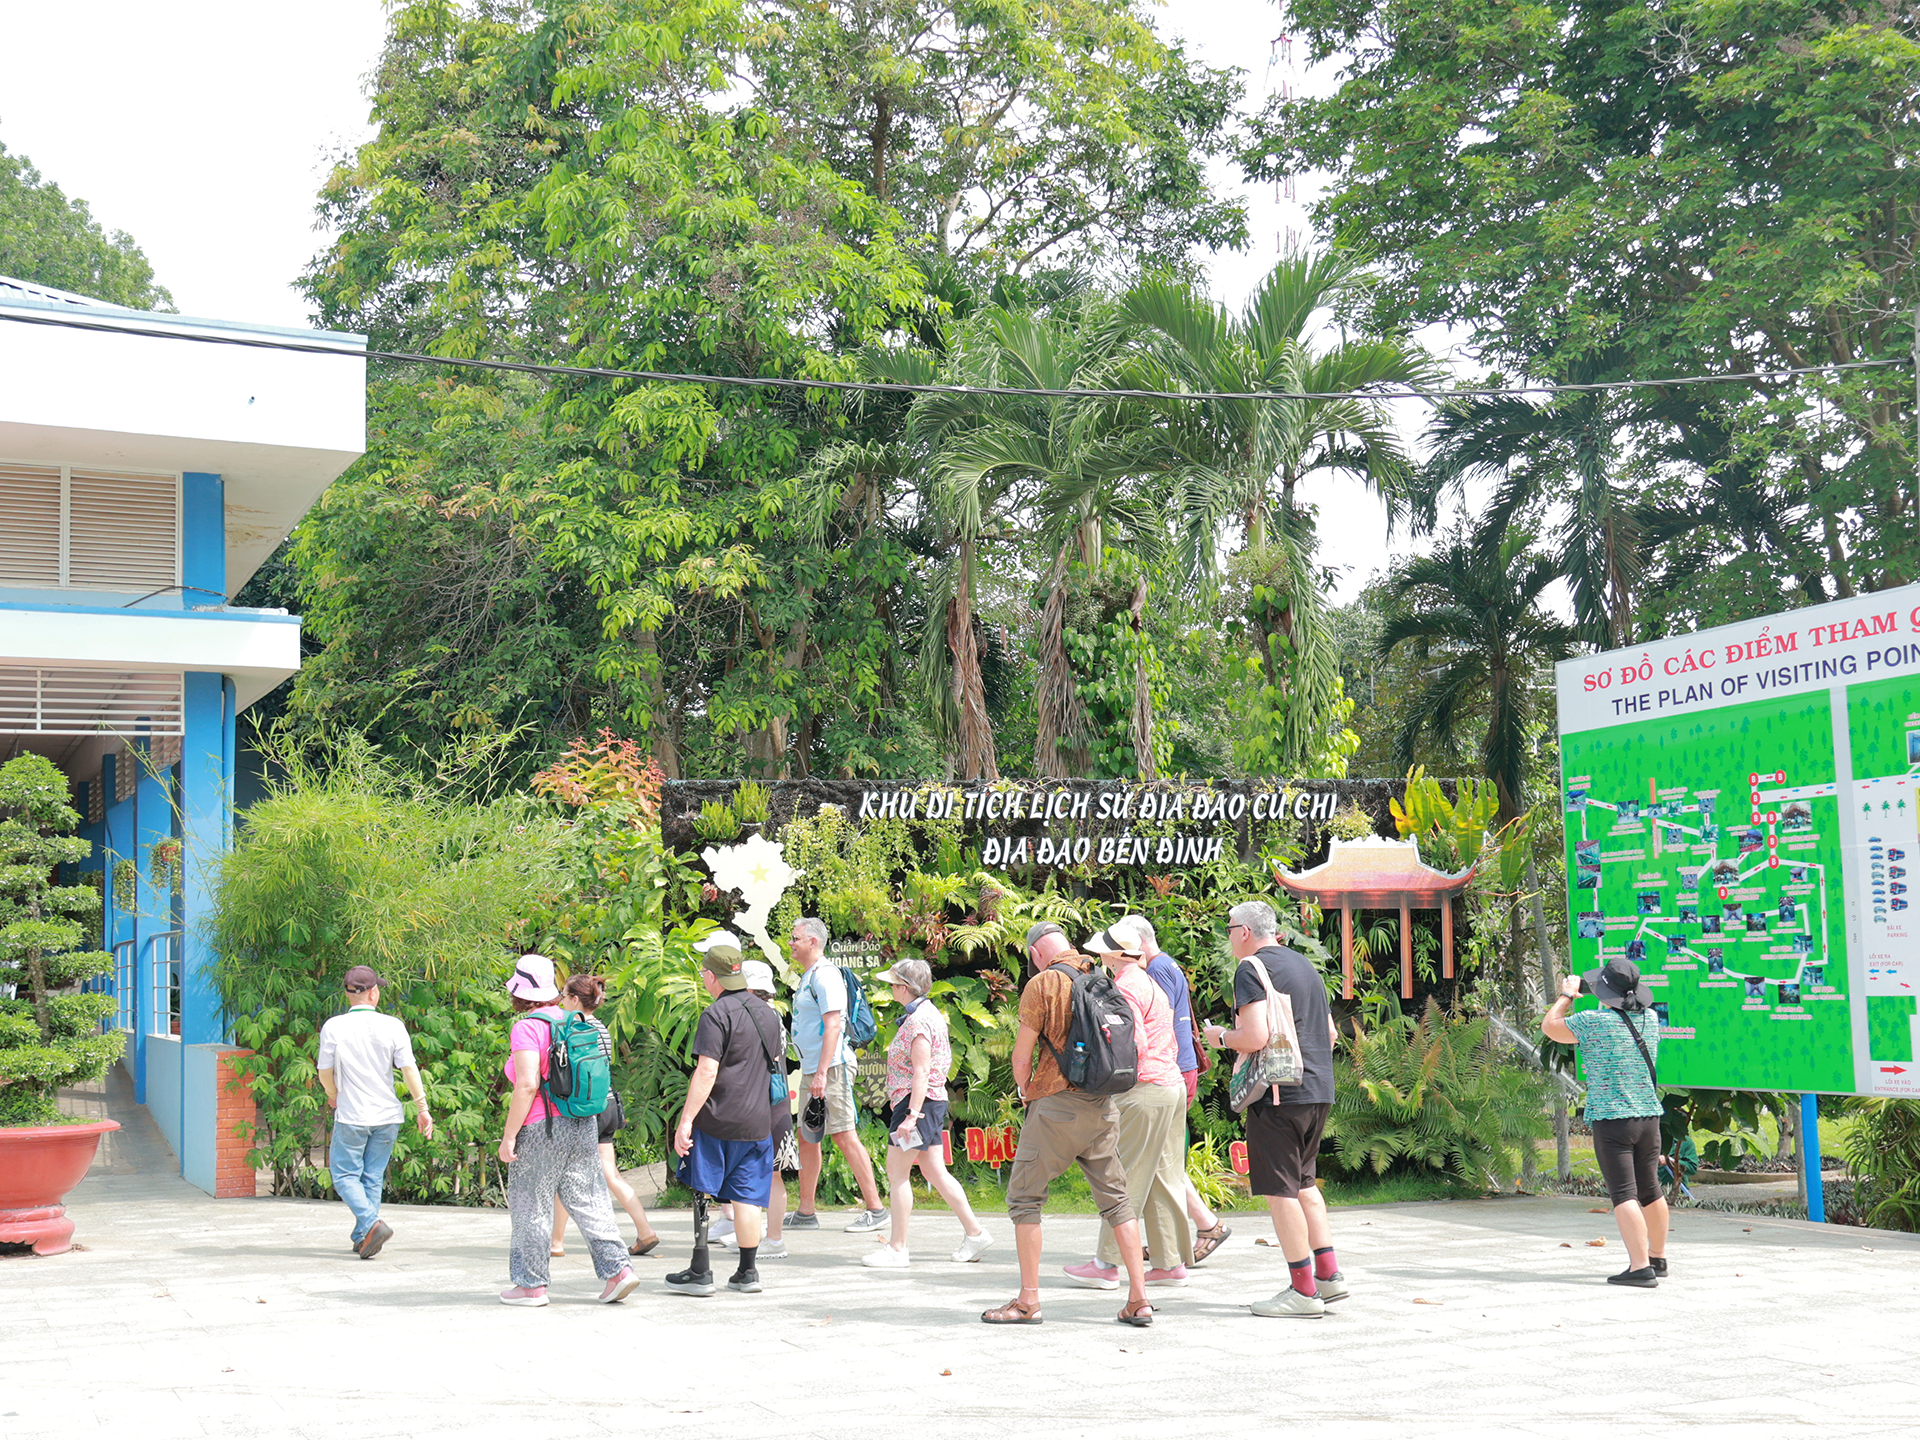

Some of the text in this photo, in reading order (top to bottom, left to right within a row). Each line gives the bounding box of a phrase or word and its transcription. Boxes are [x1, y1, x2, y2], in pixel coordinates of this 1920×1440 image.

[1583, 667, 1613, 692] SƠ
[1620, 653, 1654, 685] ĐỒ
[1663, 648, 1716, 676] CÁC
[1725, 625, 1799, 664] ĐIỂM
[1808, 611, 1898, 647] THAM
[1611, 693, 1651, 716] THE
[1658, 681, 1713, 708] PLAN
[1721, 674, 1749, 696] OF
[1756, 654, 1857, 690] VISITING
[858, 790, 918, 819] KHU
[925, 791, 954, 819] DI
[963, 786, 1023, 820] TÍCH
[1029, 791, 1091, 827] LỊCH
[1138, 792, 1183, 827] ĐỊA
[1191, 792, 1246, 827] ĐẠO
[1252, 786, 1288, 820] CỦ
[1293, 792, 1338, 820] CHI
[982, 826, 1223, 871] ĐỊA ĐẠO BẾN ĐÌNH
[866, 955, 880, 968] SA
[858, 1061, 887, 1076] RƯỜN
